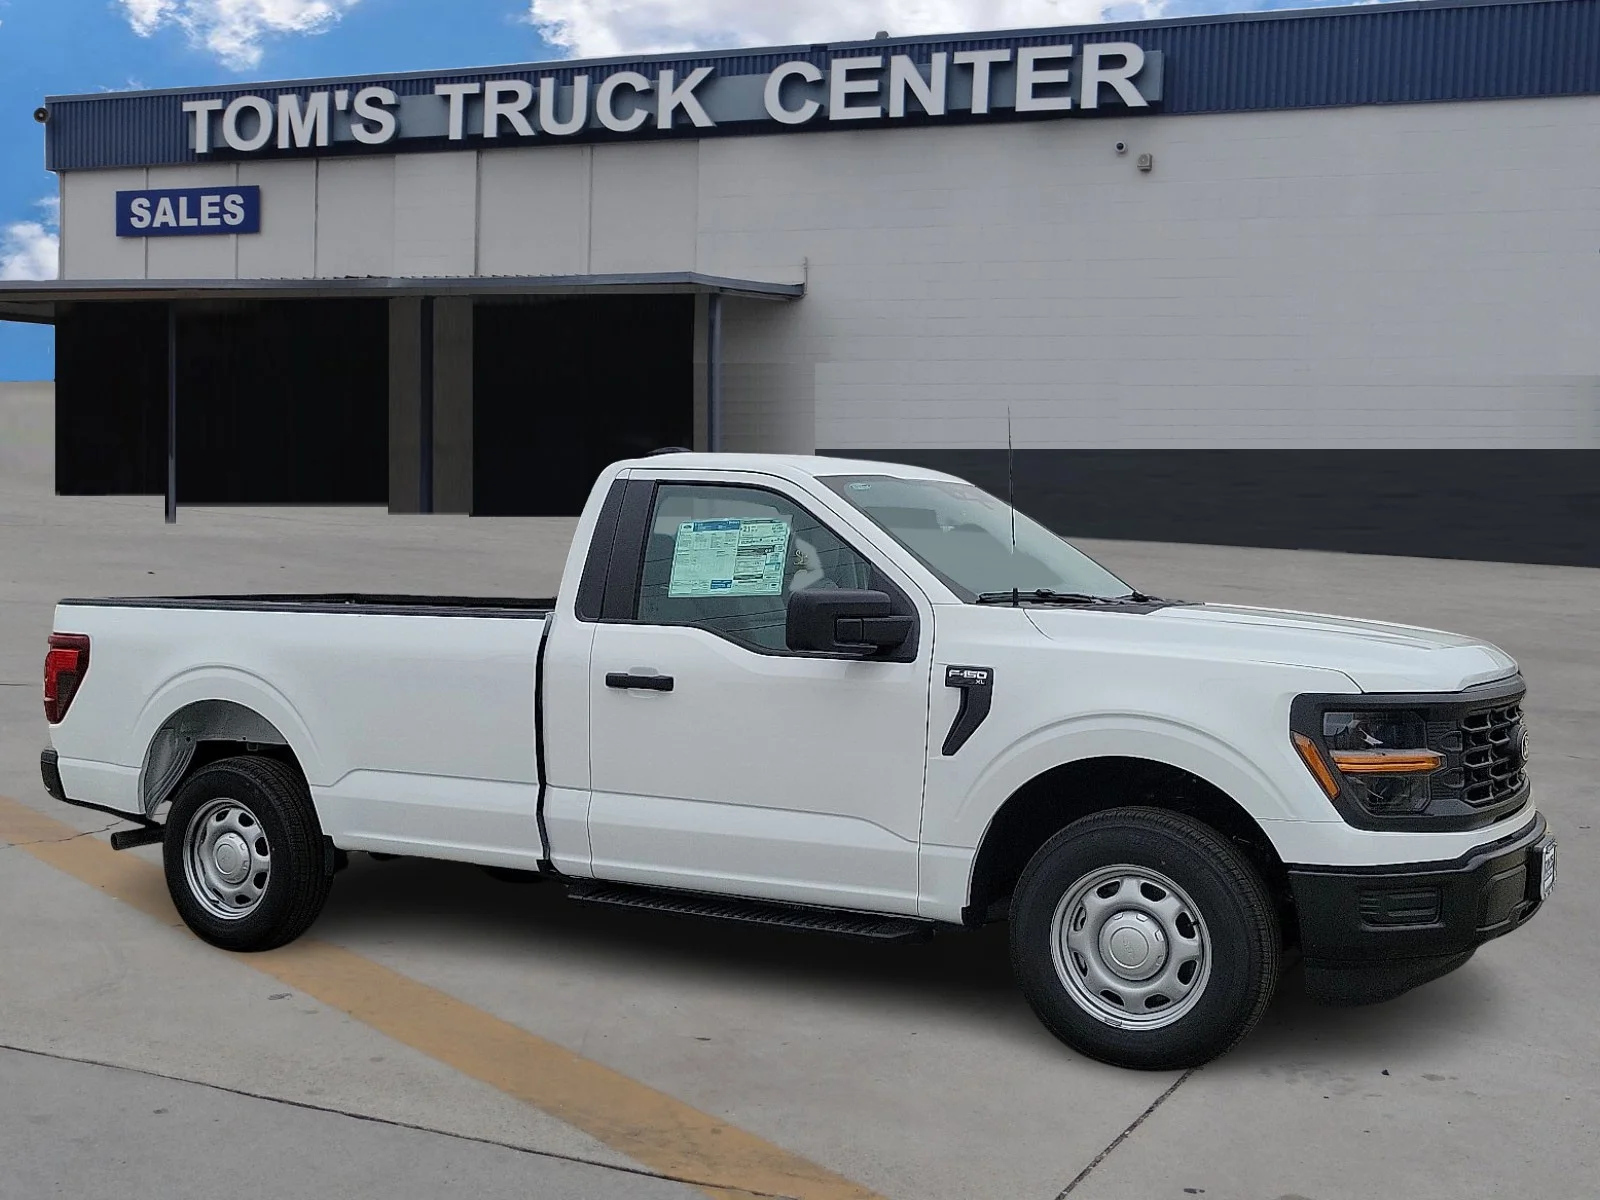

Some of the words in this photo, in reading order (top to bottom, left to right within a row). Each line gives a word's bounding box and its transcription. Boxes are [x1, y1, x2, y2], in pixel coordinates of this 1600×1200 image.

[182, 86, 398, 154] TOM'S
[434, 66, 716, 140] TRUCK
[763, 41, 1149, 125] CENTER
[129, 193, 246, 229] SALES
